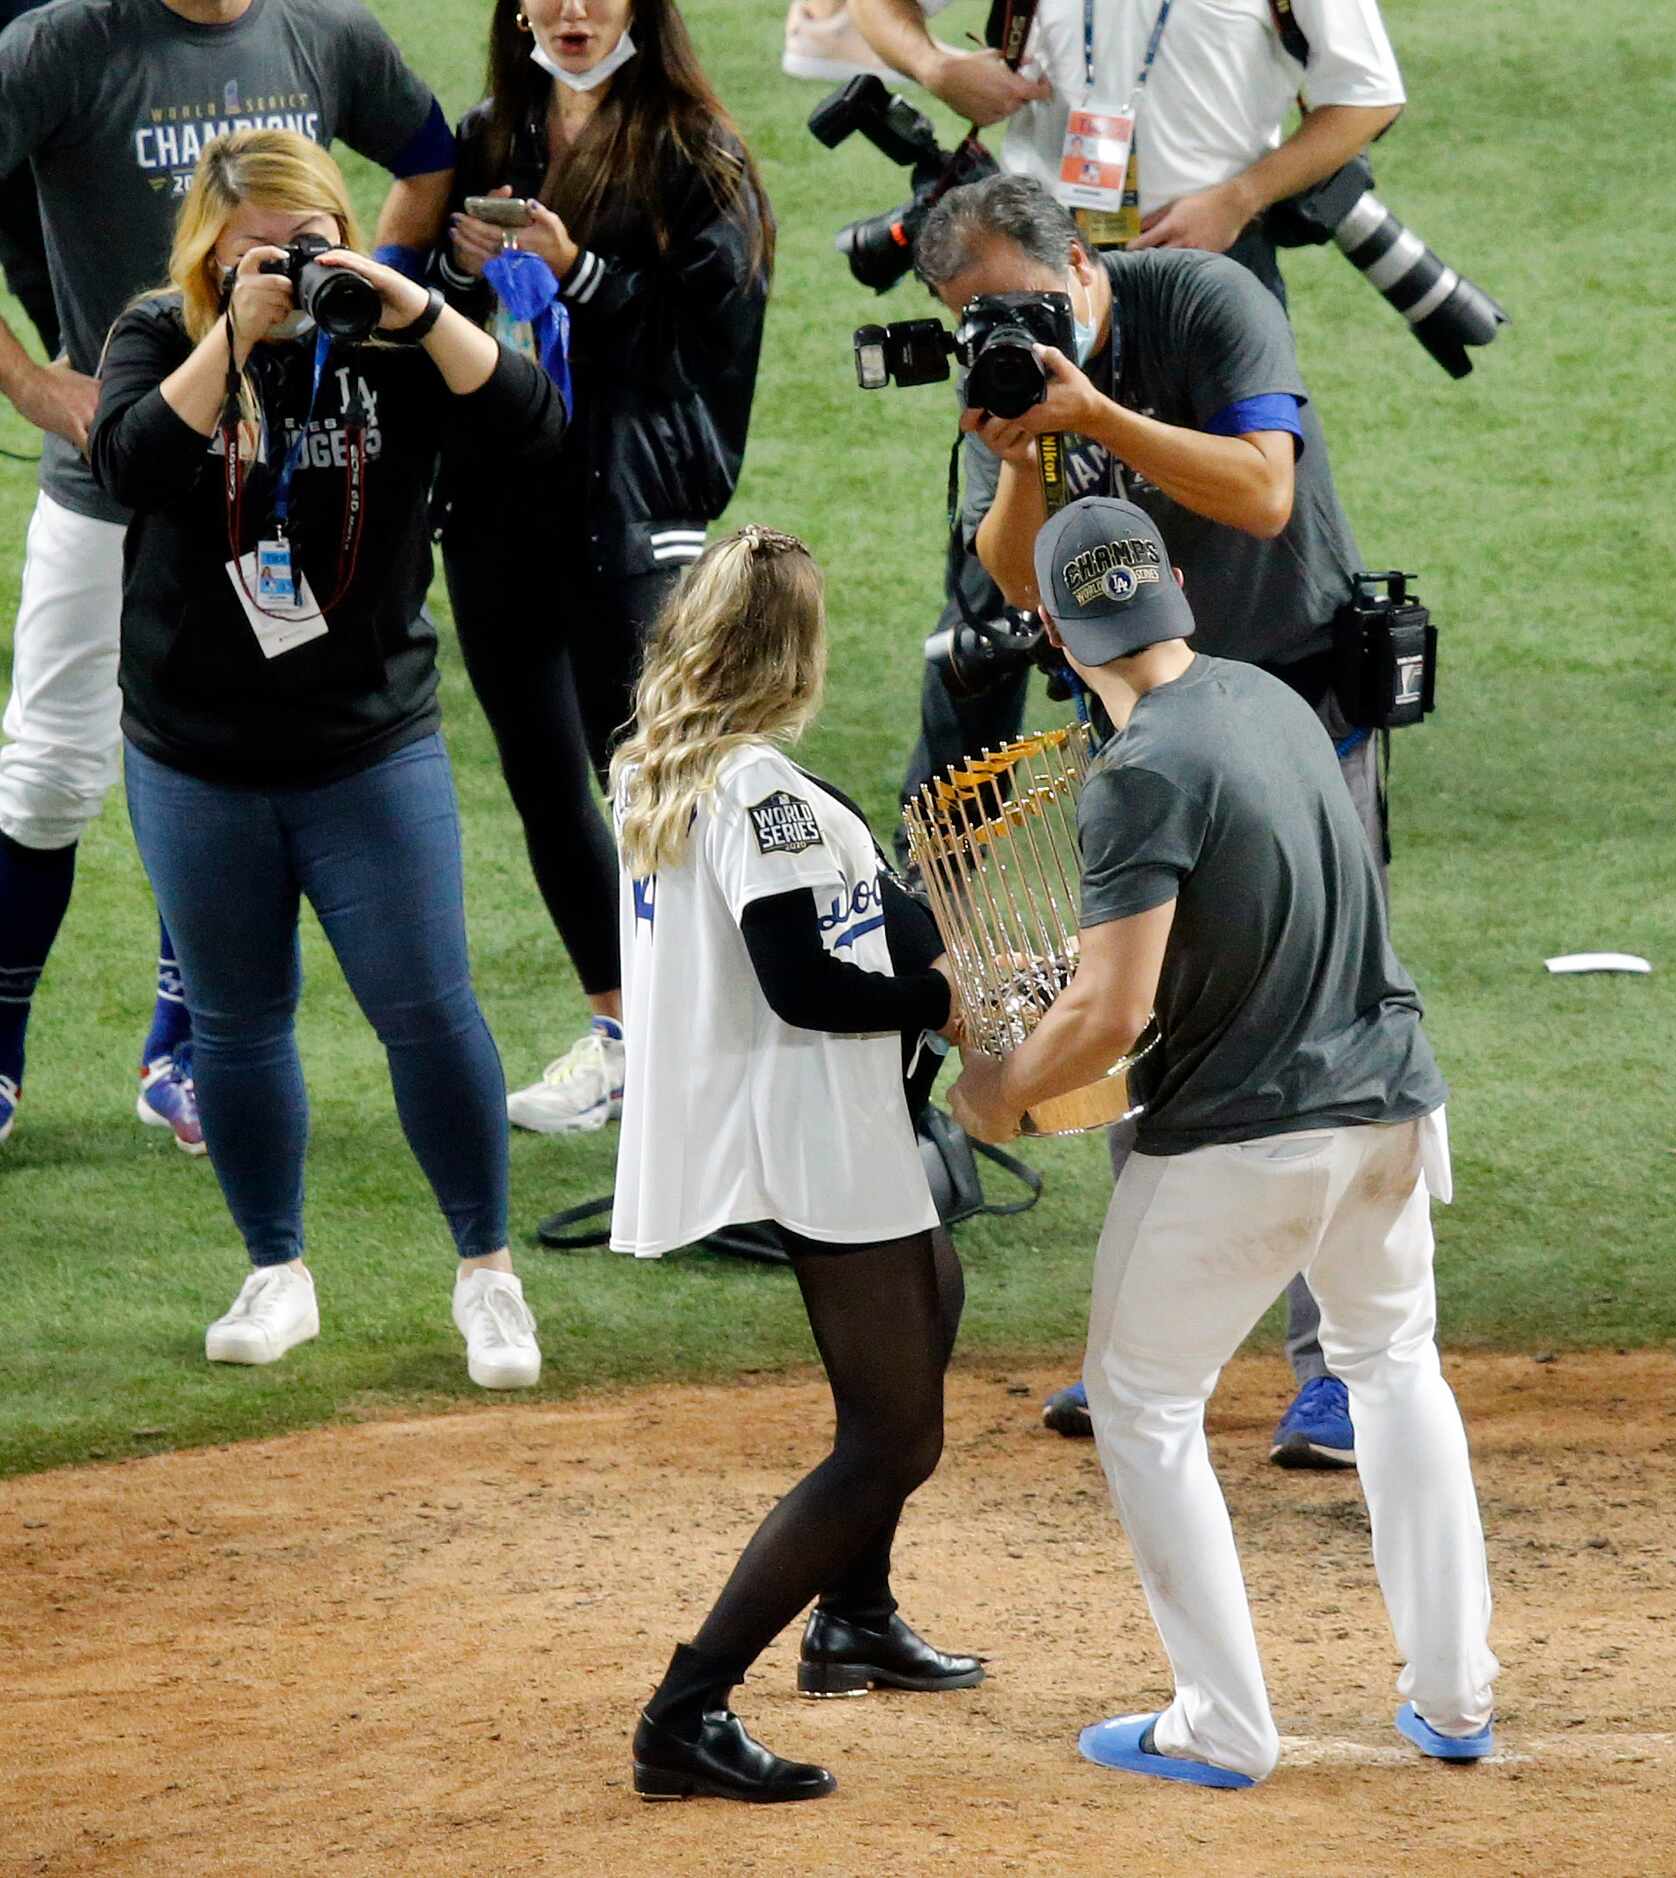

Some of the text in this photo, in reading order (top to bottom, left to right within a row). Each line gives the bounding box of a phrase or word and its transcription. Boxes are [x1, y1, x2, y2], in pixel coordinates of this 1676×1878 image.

[151, 93, 308, 123] WORLD SERIES
[1042, 435, 1057, 483] Nikon
[1063, 539, 1160, 589] CHAMPS
[1111, 574, 1128, 594] LA
[753, 804, 813, 828] WORLD
[760, 821, 819, 848] SERIES
[784, 841, 807, 851] 2020
